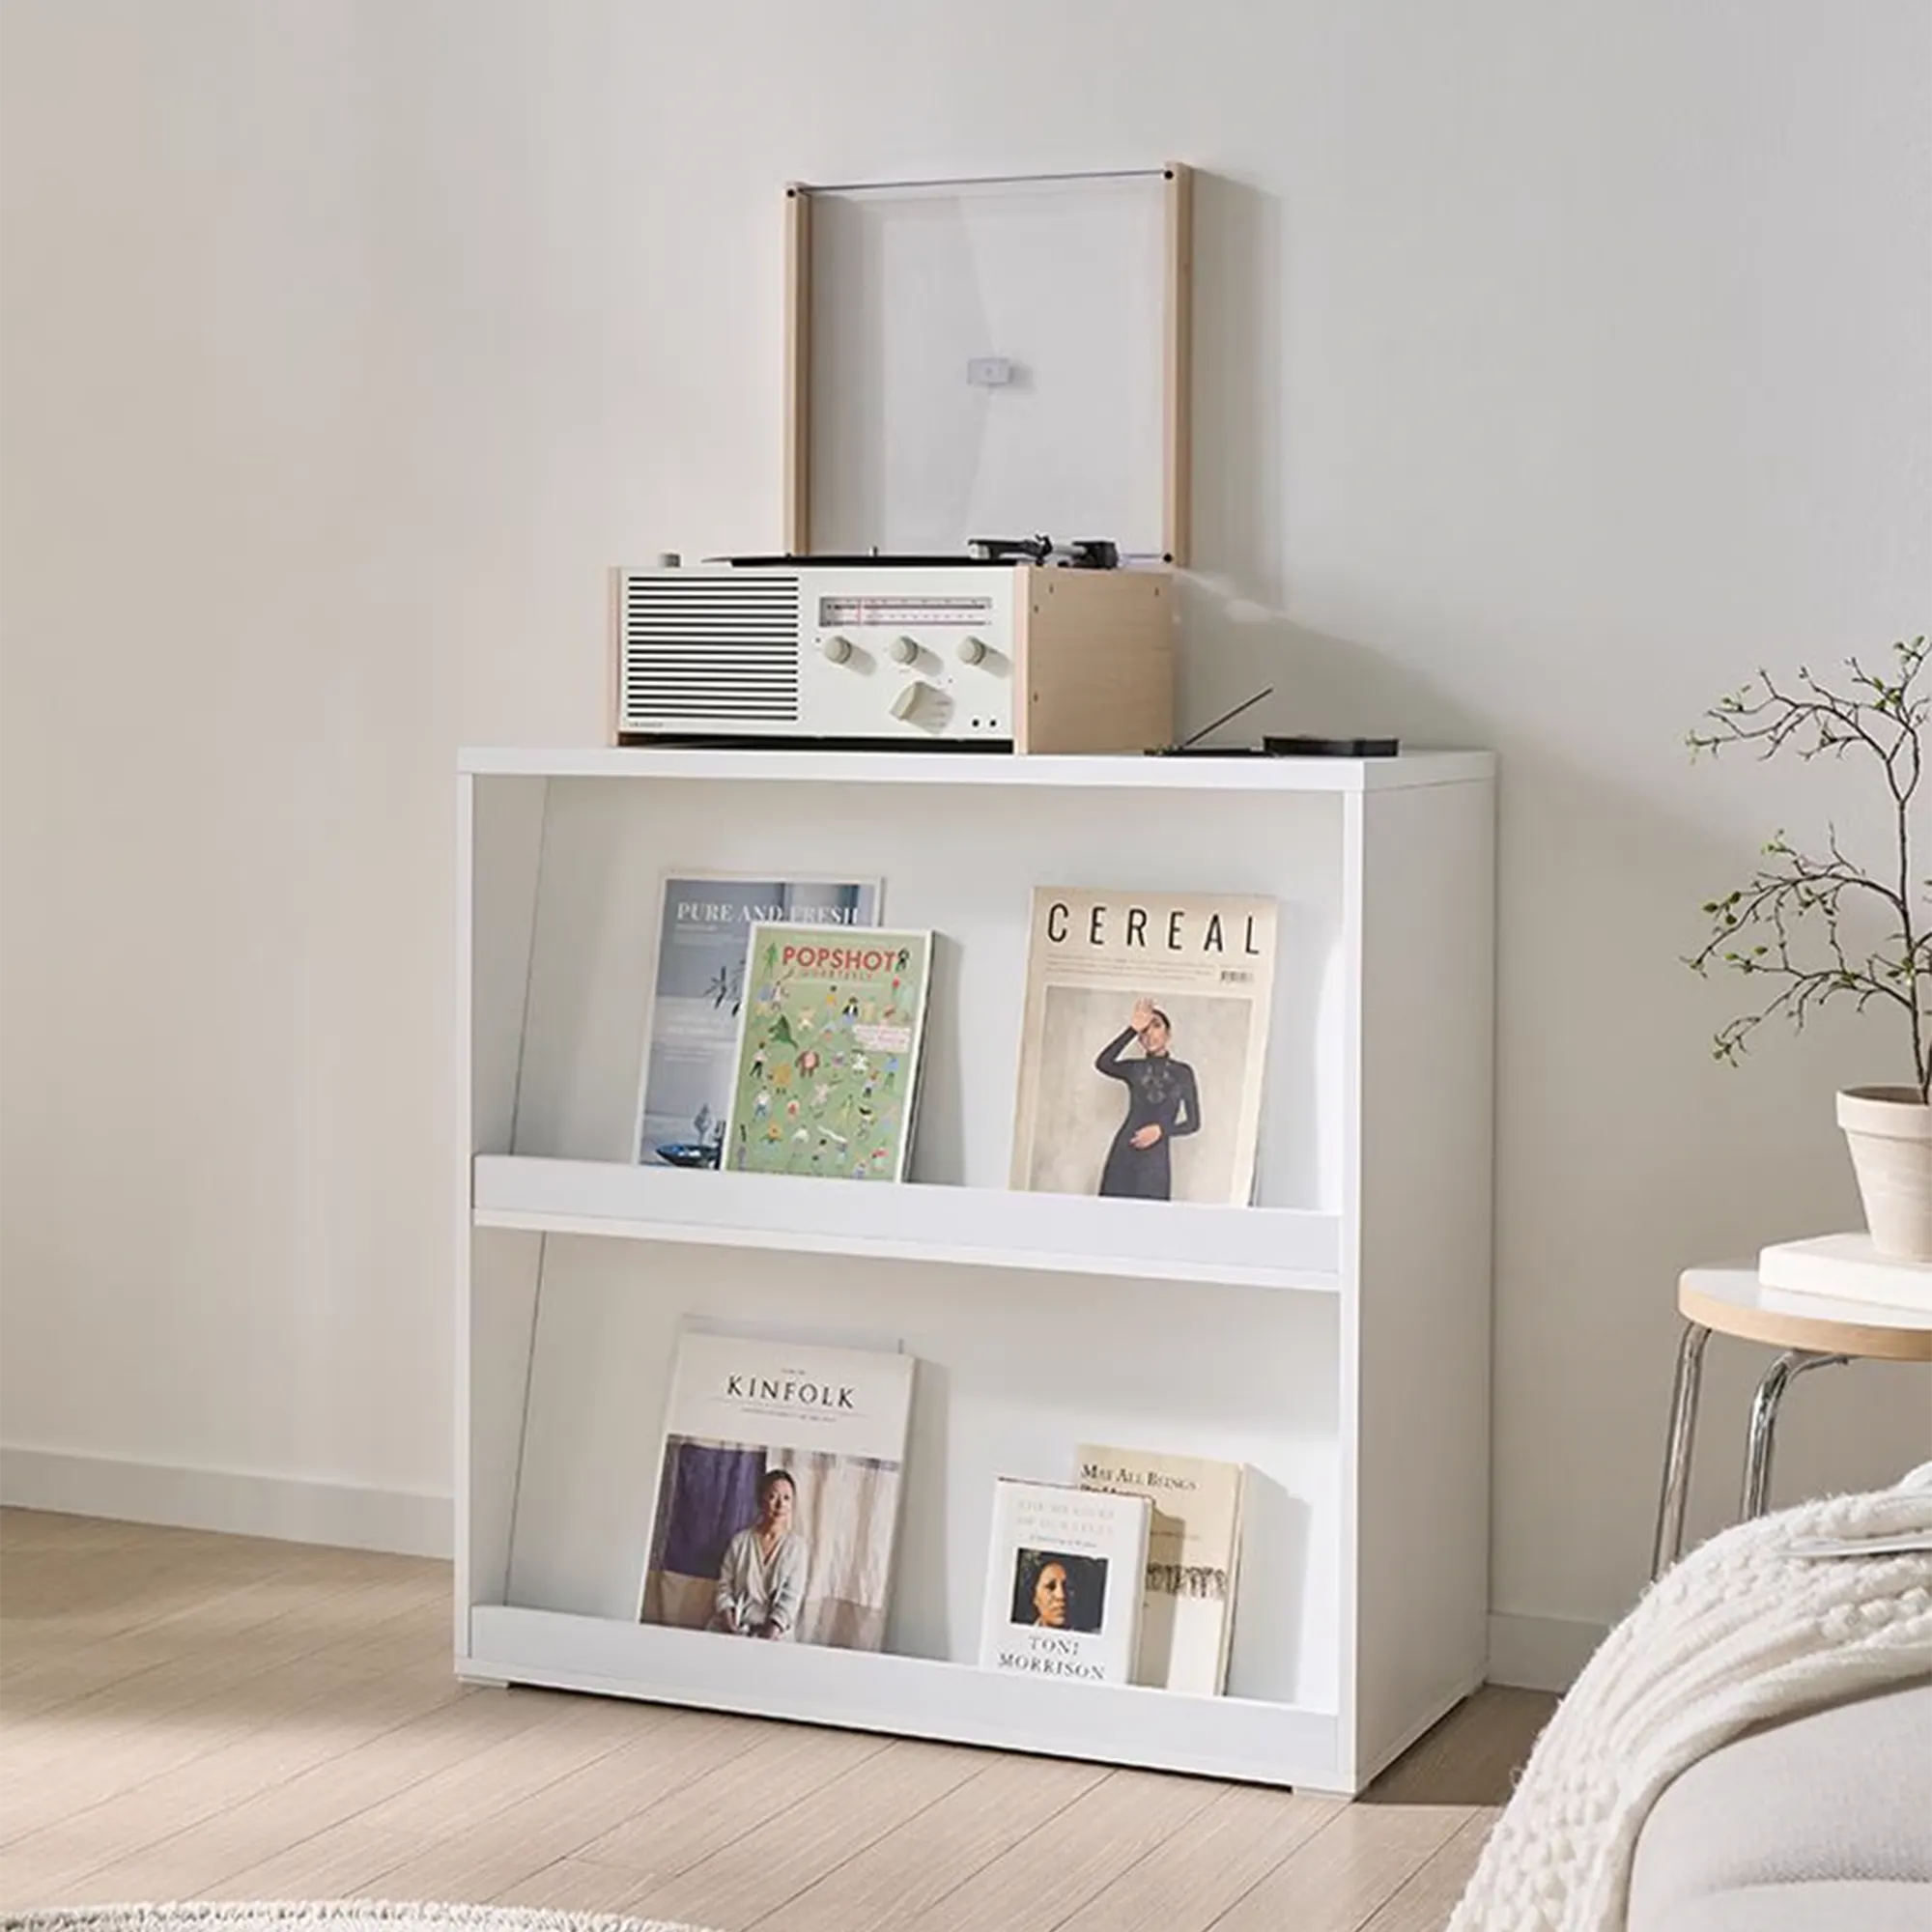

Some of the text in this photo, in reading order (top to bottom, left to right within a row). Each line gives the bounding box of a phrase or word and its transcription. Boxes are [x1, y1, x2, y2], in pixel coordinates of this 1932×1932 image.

[676, 902, 860, 924] PURE AND FRESH
[1046, 902, 1261, 955] CEREAL
[781, 946, 895, 972] POPSHOT
[726, 1374, 855, 1409] KINFOLK
[1028, 1634, 1079, 1657] TONI
[997, 1652, 1105, 1680] MORRISON
